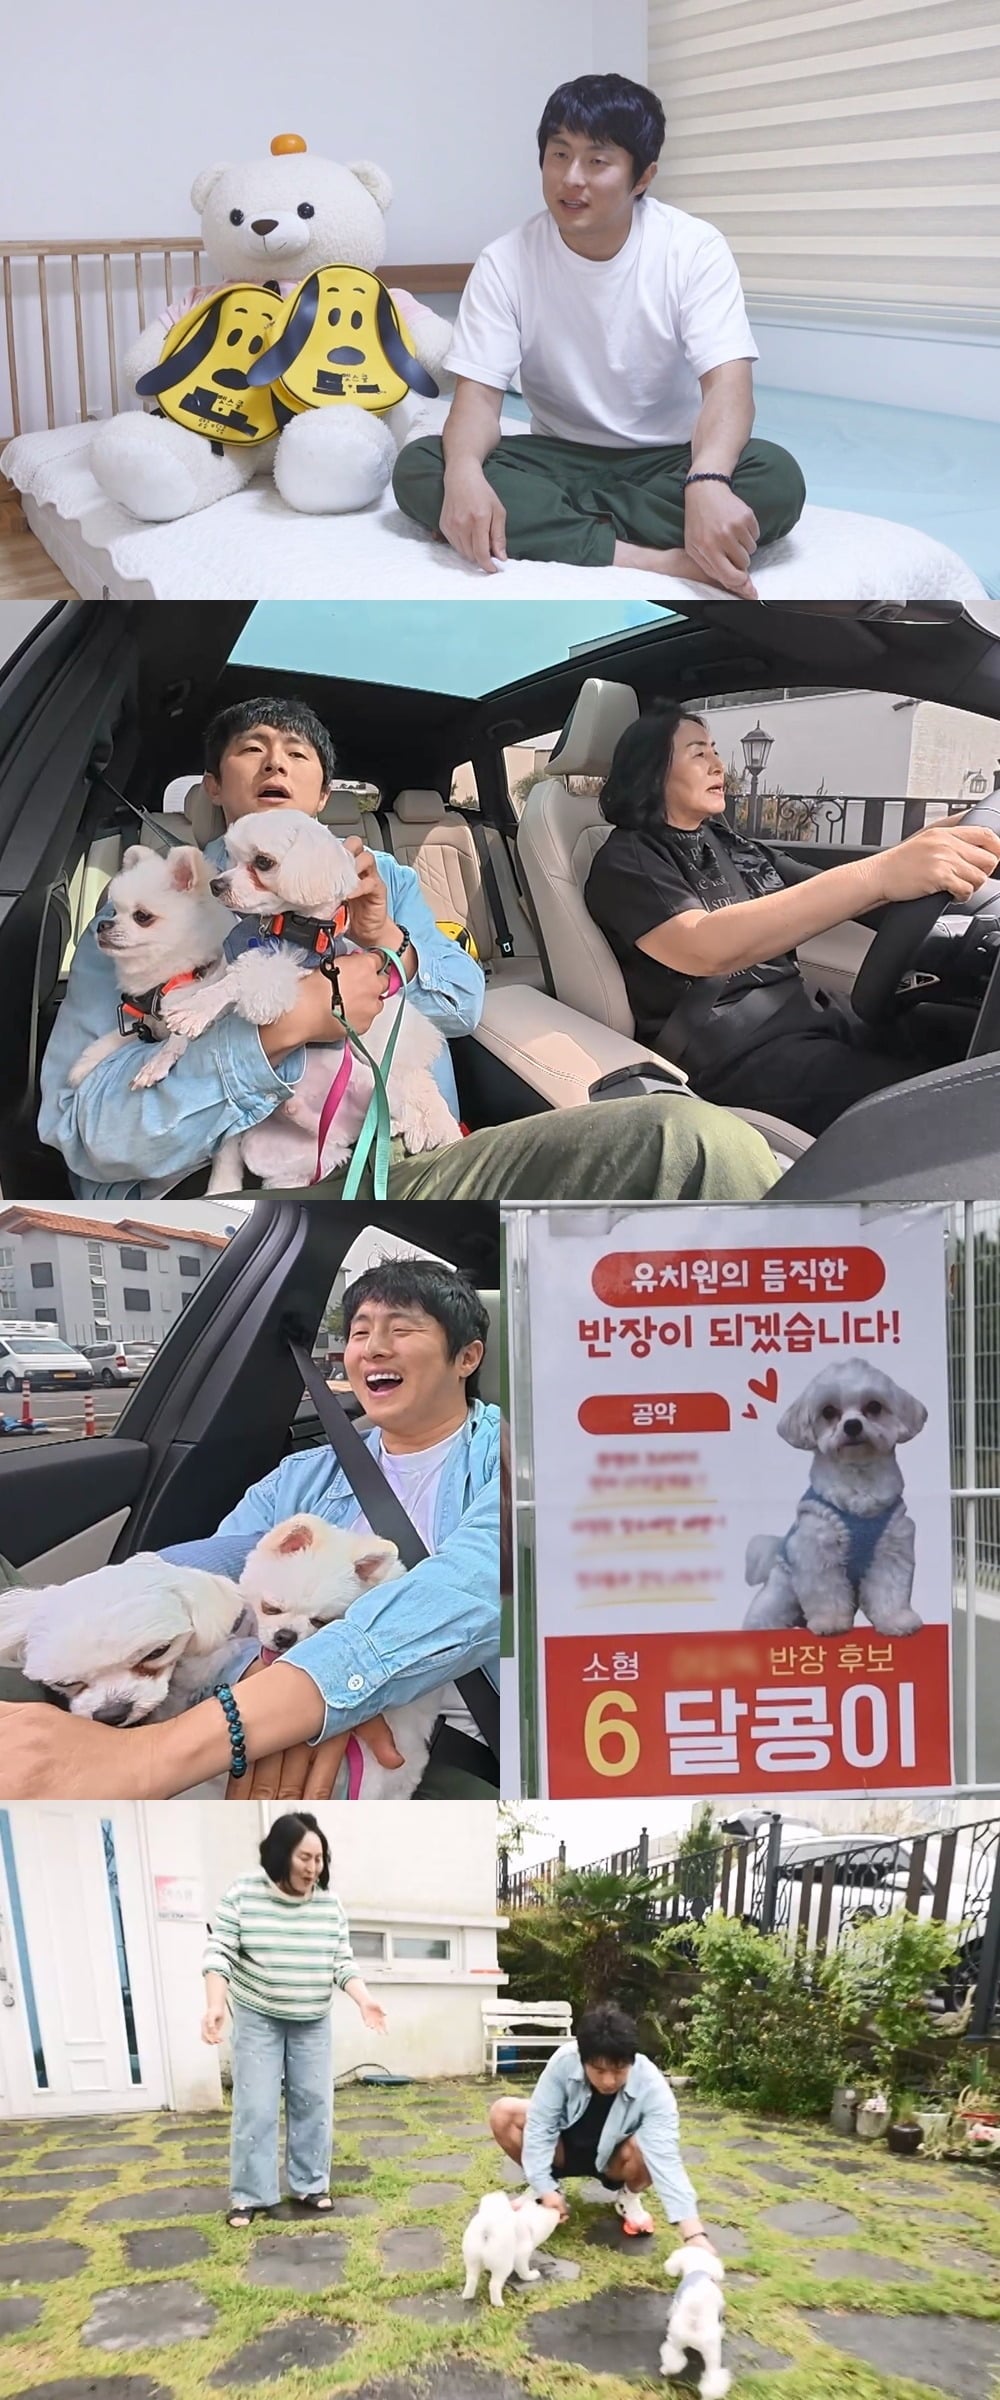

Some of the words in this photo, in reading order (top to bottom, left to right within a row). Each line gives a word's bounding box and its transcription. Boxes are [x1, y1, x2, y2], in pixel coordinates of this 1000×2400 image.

[631, 1259, 749, 1294] 유치원의
[761, 1258, 849, 1293] 듬직한
[578, 1315, 692, 1358] 반장이
[709, 1310, 900, 1353] 되겠습니다!
[632, 1402, 677, 1426] 공약
[582, 1651, 639, 1682] 소형
[770, 1645, 827, 1676] 반장
[837, 1643, 894, 1673] 후보
[584, 1690, 641, 1777] 6
[664, 1682, 916, 1776] 달콩이
